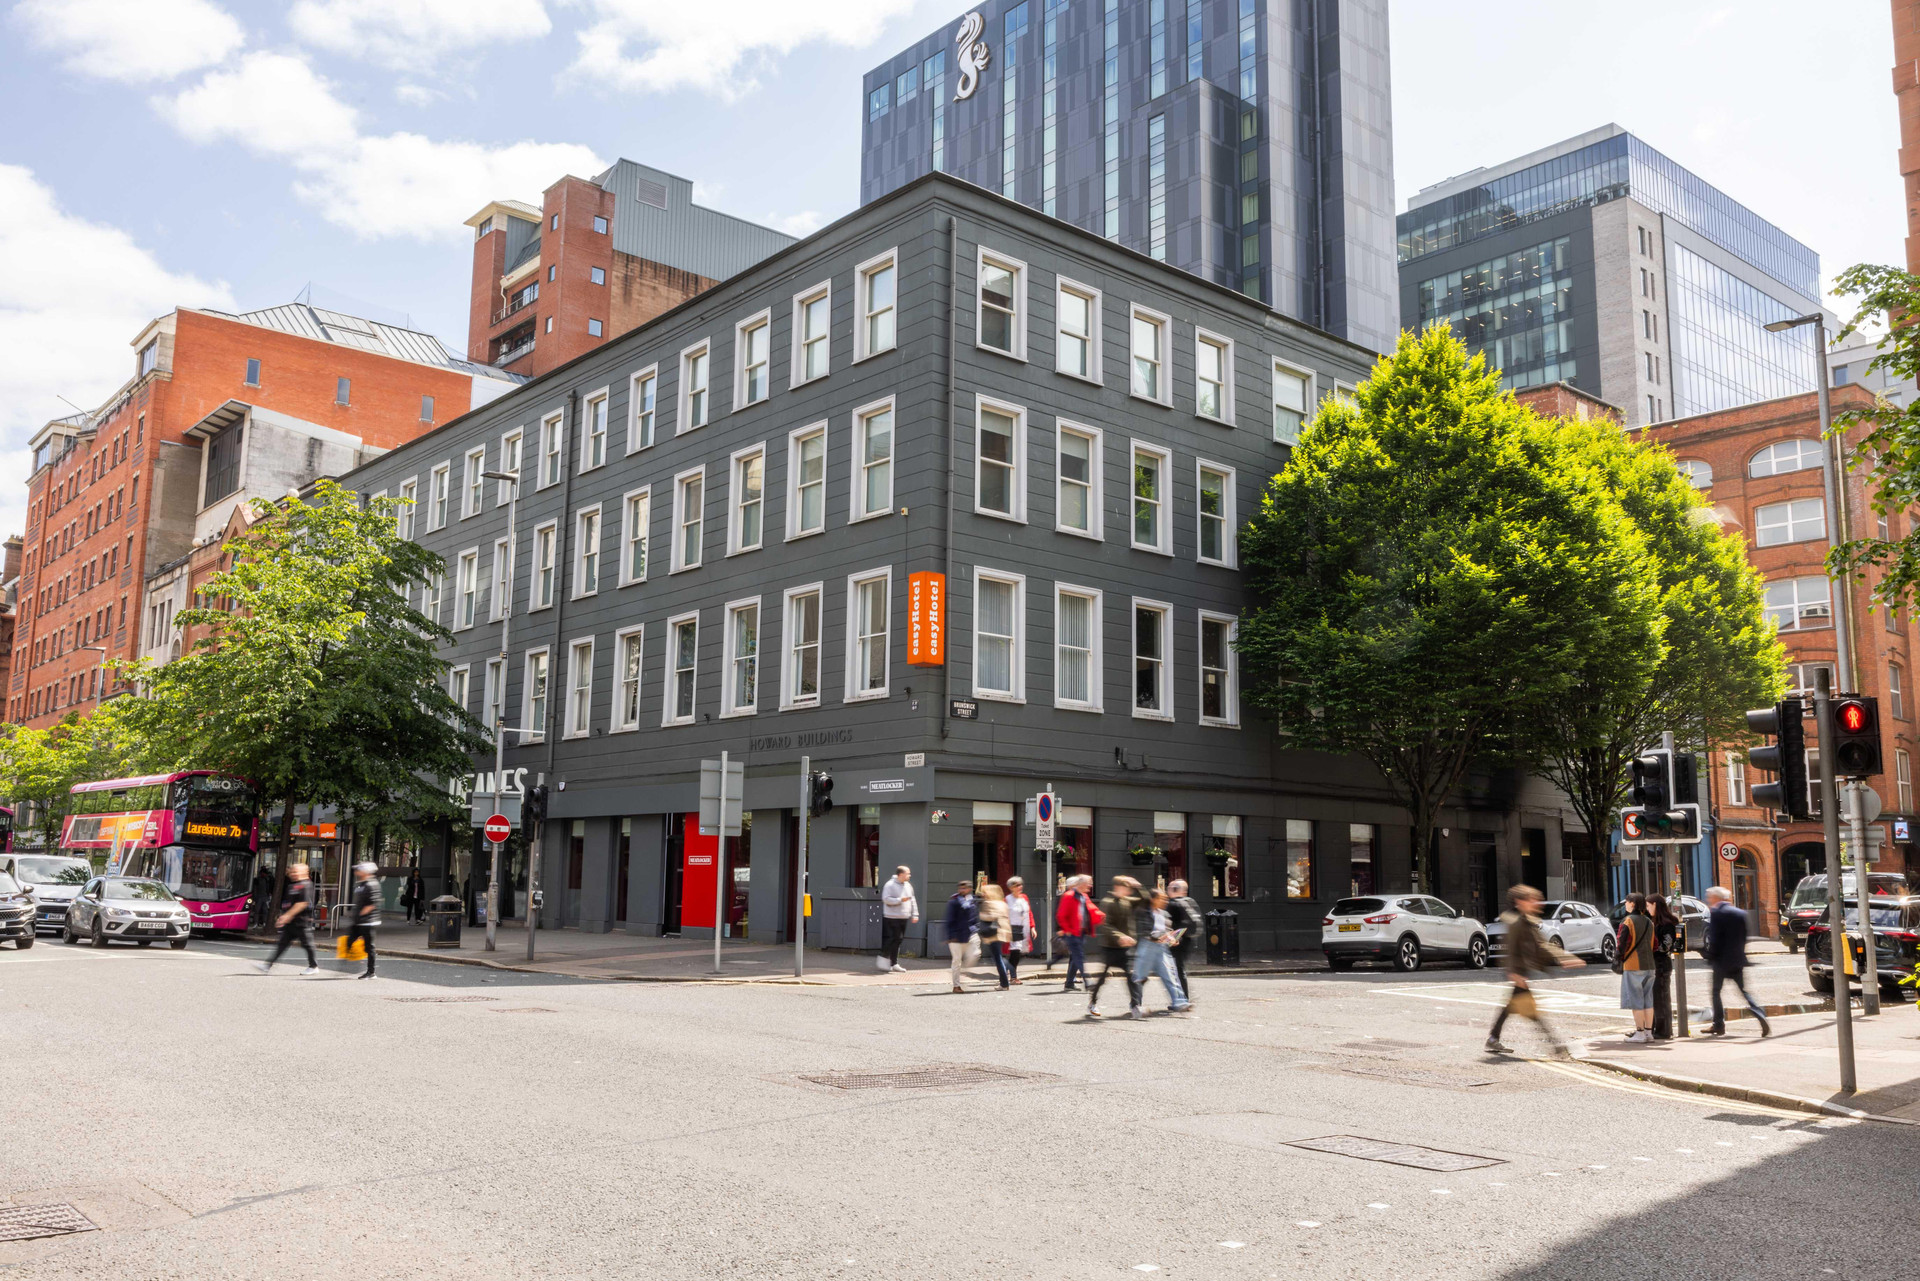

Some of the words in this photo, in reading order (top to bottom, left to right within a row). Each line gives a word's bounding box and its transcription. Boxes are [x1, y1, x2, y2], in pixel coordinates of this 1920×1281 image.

[912, 580, 920, 656] easyHotel
[929, 580, 939, 656] easyHotel
[953, 701, 976, 710] BRUNSWICK
[957, 708, 972, 716] STREET
[750, 736, 792, 751] HOWARD
[798, 730, 853, 747] BUILDINGS
[871, 782, 903, 790] MEATLOCKER
[230, 825, 242, 837] 7b
[1039, 829, 1051, 837] ZONE
[1722, 847, 1738, 857] 30
